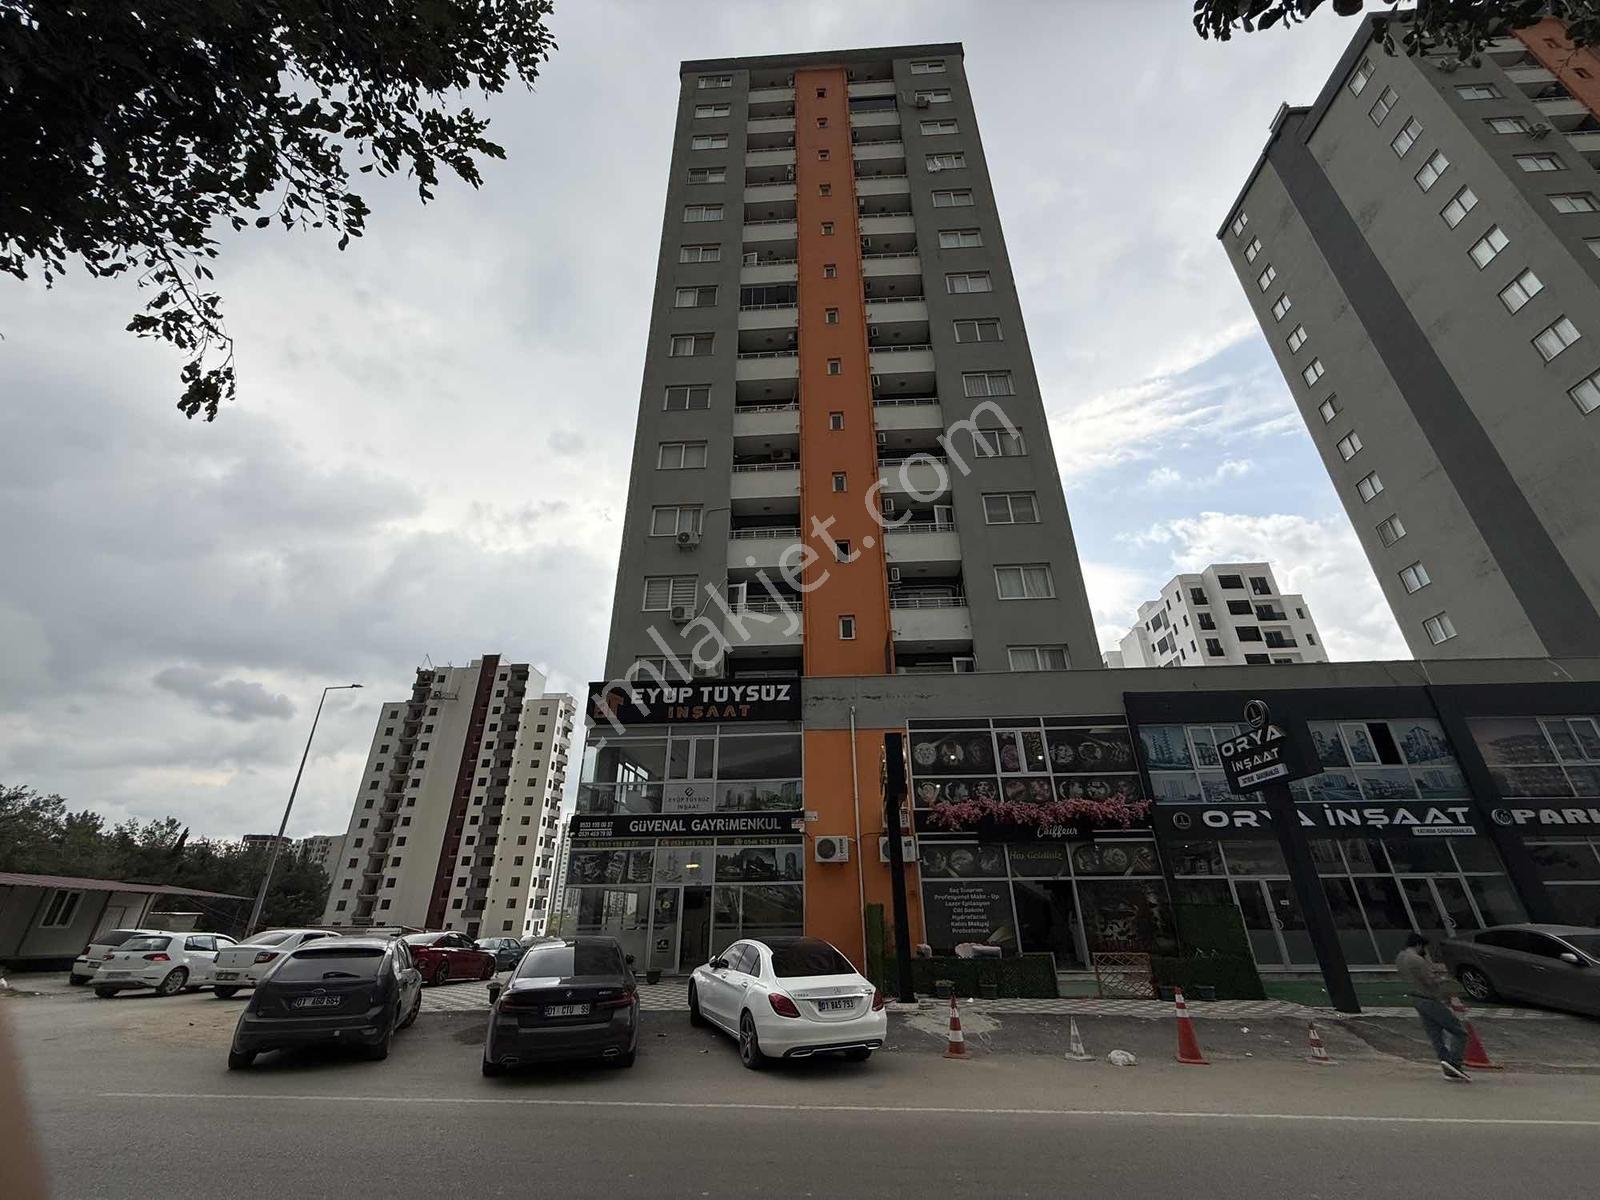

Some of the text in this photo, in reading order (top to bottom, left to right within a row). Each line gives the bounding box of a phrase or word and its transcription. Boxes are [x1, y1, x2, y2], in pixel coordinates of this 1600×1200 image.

[631, 684, 791, 705] EYÜP TÜYSÜZ
[1221, 725, 1284, 757] ORYA
[1202, 803, 1469, 830] ORA İNŞAAT
